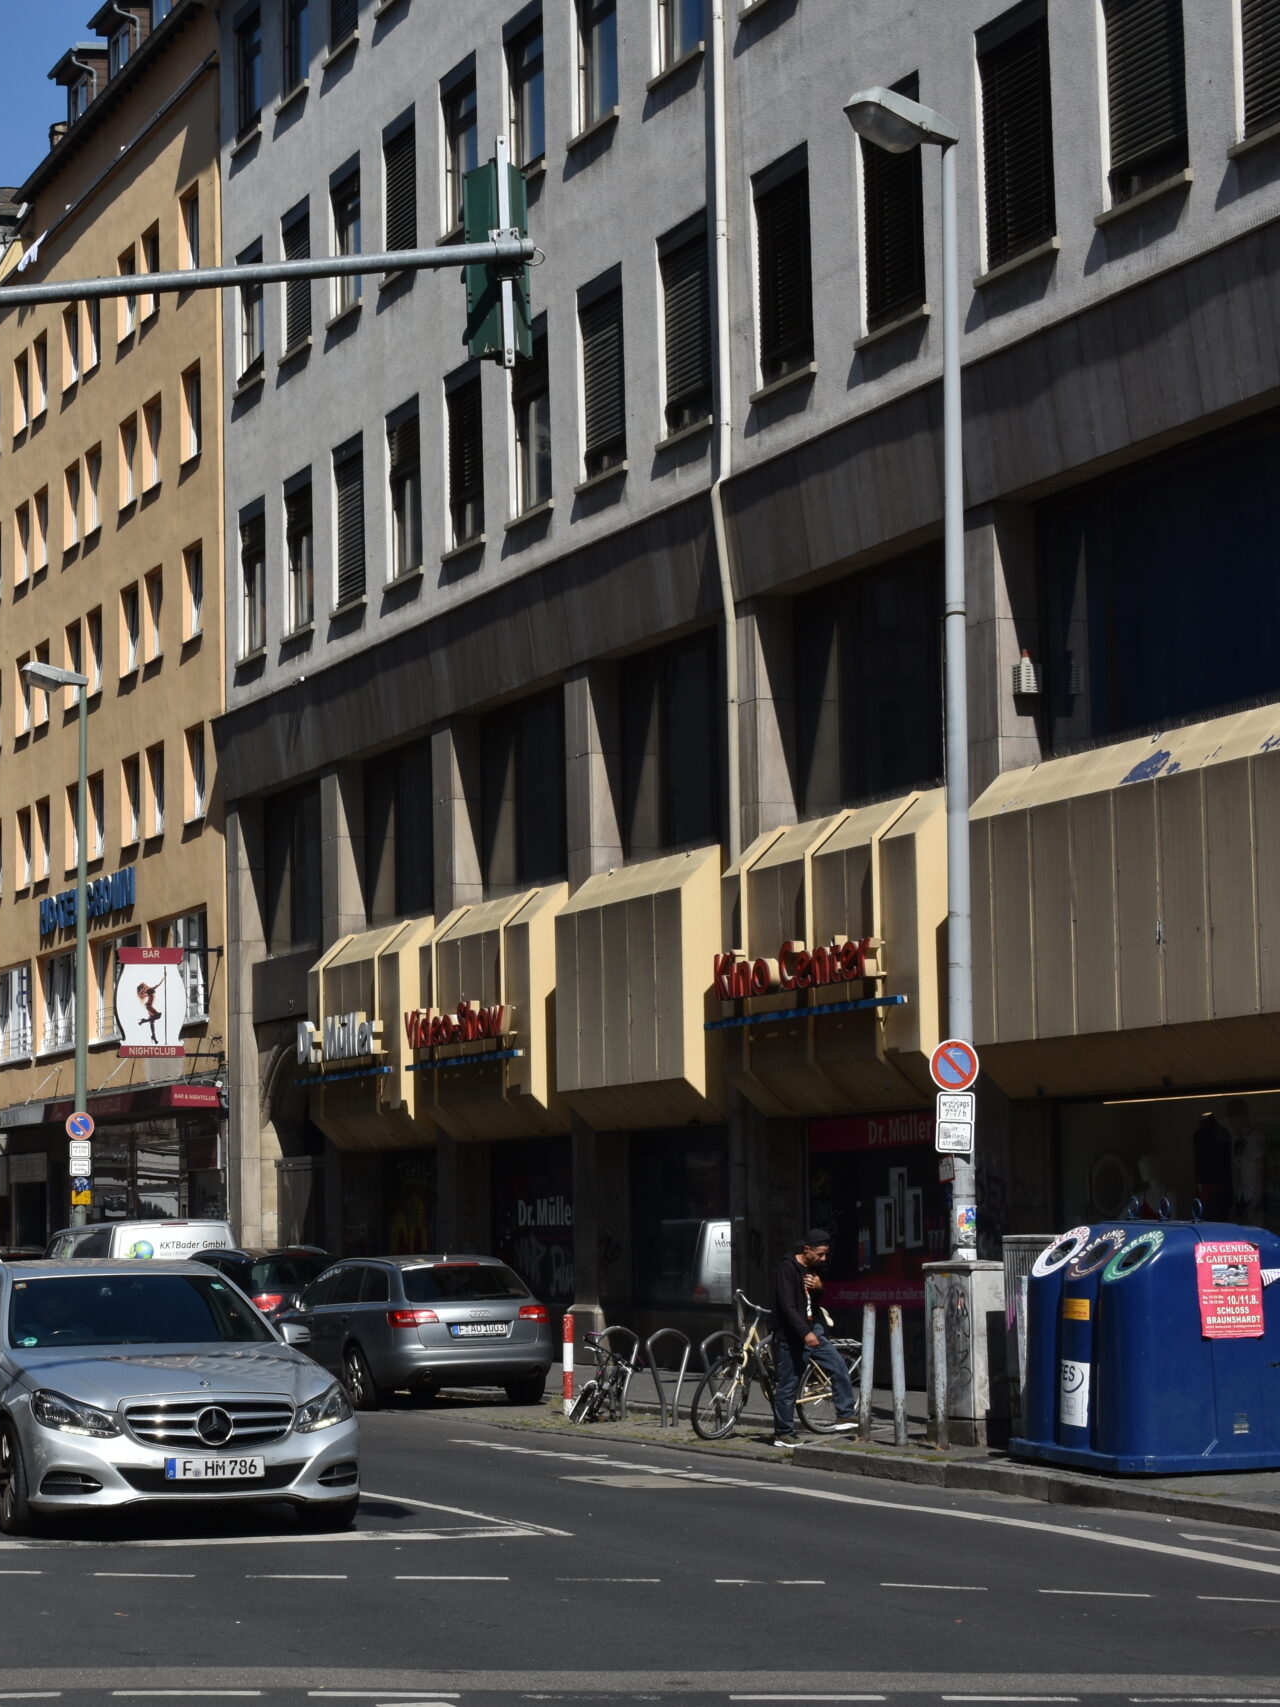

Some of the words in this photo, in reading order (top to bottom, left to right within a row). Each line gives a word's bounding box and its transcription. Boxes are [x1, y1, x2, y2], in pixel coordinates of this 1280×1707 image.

[142, 949, 160, 959] BAR
[713, 948, 771, 1000] Kino
[779, 936, 876, 990] Center
[404, 1000, 508, 1049] Video-Show
[128, 1047, 177, 1056] NIGHTCLUB
[869, 1120, 887, 1145] Dr.
[889, 1114, 933, 1143] Müller
[518, 1200, 535, 1226] Dr.
[202, 1240, 227, 1249] GmbH
[1199, 1245, 1218, 1253] DAS
[1219, 1244, 1255, 1253] GENUSS
[1196, 1255, 1204, 1264] &
[1206, 1254, 1259, 1263] GARTENFEST
[1216, 1306, 1250, 1315] SCHLOSS
[1206, 1315, 1261, 1325] BRAUNSHARDT
[182, 1460, 194, 1476] F
